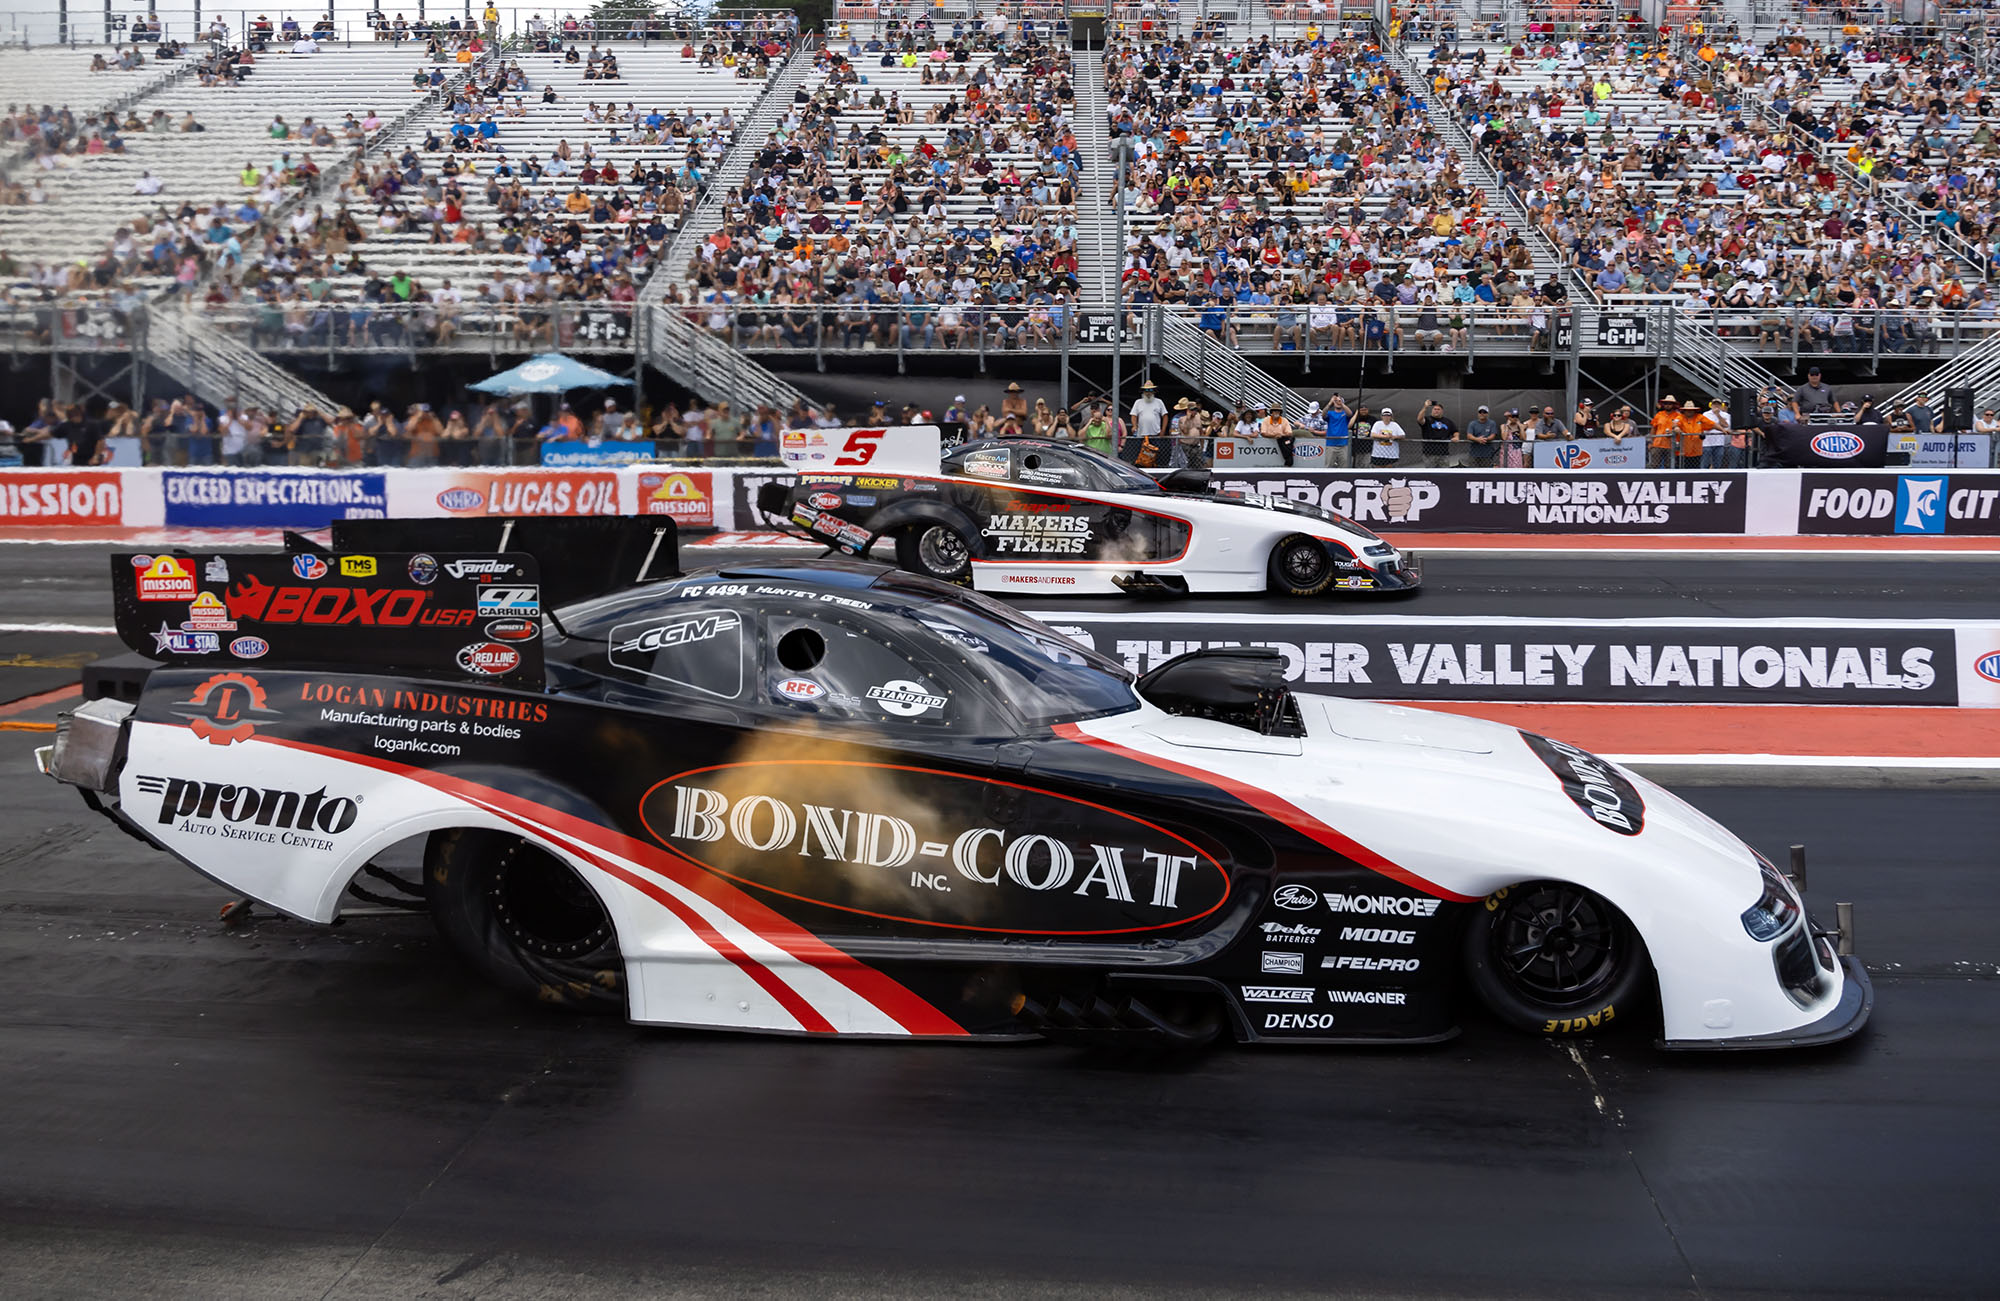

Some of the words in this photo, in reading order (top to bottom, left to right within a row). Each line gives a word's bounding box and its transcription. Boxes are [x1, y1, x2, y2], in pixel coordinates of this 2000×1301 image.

[1607, 328, 1637, 345] G-H
[834, 429, 887, 465] 5
[1238, 446, 1279, 455] TOYOTA
[1294, 445, 1319, 457] NHRA
[1820, 437, 1856, 452] NHRA
[1900, 443, 1917, 451] NAPA
[1922, 442, 1946, 452] AUTO
[1556, 445, 1580, 468] VP
[167, 476, 232, 505] EXCEED
[863, 478, 899, 488] KICKER
[1466, 480, 1609, 505] THUNDER
[1618, 480, 1733, 505] VALLEY
[442, 489, 481, 509] NHRA
[487, 481, 572, 514] LUCAS
[575, 481, 617, 514] OIL
[1006, 500, 1071, 514] Snap-on
[1807, 488, 1895, 519] FOOD
[1948, 488, 2000, 519] CIT
[989, 515, 1090, 532] MAKERS
[1527, 504, 1670, 525] NATIONALS
[996, 536, 1086, 554] FIXERS
[293, 554, 316, 578] VP
[345, 559, 372, 570] TMS
[444, 559, 515, 579] Sander
[1009, 575, 1076, 585] MAKERSANDFIXERS
[264, 586, 427, 626] BOXO
[418, 609, 477, 626] USA
[480, 588, 538, 608] CP
[681, 585, 703, 598] FC
[705, 585, 749, 597] 4494
[754, 586, 817, 600] HUNTER
[820, 594, 873, 610] GREEN
[479, 607, 539, 616] CARRILLO
[172, 635, 190, 649] ALL
[195, 635, 218, 649] STAR
[637, 616, 720, 653] CGM
[236, 642, 264, 655] NHRA
[475, 652, 493, 663] RED
[494, 652, 516, 663] LINE
[1387, 643, 1596, 686] VALLEY
[1609, 644, 1936, 690] NATIONALS
[785, 680, 817, 695] RFC
[871, 687, 942, 706] STANDARD
[301, 682, 387, 708] LOGAN
[393, 690, 549, 723] INDUSTRIES
[320, 708, 418, 732] Manufacturing
[420, 719, 456, 734] parts
[459, 721, 470, 735] &
[473, 722, 522, 740] bodies
[374, 735, 461, 756] logankc.com
[157, 777, 359, 835] pronto
[670, 785, 1198, 909] BOND-COAT
[910, 871, 952, 893] INC.
[1278, 887, 1315, 906] Gates
[1337, 894, 1426, 917] MONROE
[1265, 934, 1317, 944] BATTERIES
[1339, 927, 1417, 945] MOOG
[1265, 958, 1301, 967] CHAMPION
[1336, 956, 1420, 972] FEL-PRO
[1242, 986, 1315, 1004] WALKER
[1340, 991, 1406, 1005] WAGNER
[1264, 1013, 1335, 1029] DENSO
[1542, 1004, 1616, 1033] EAGLE
